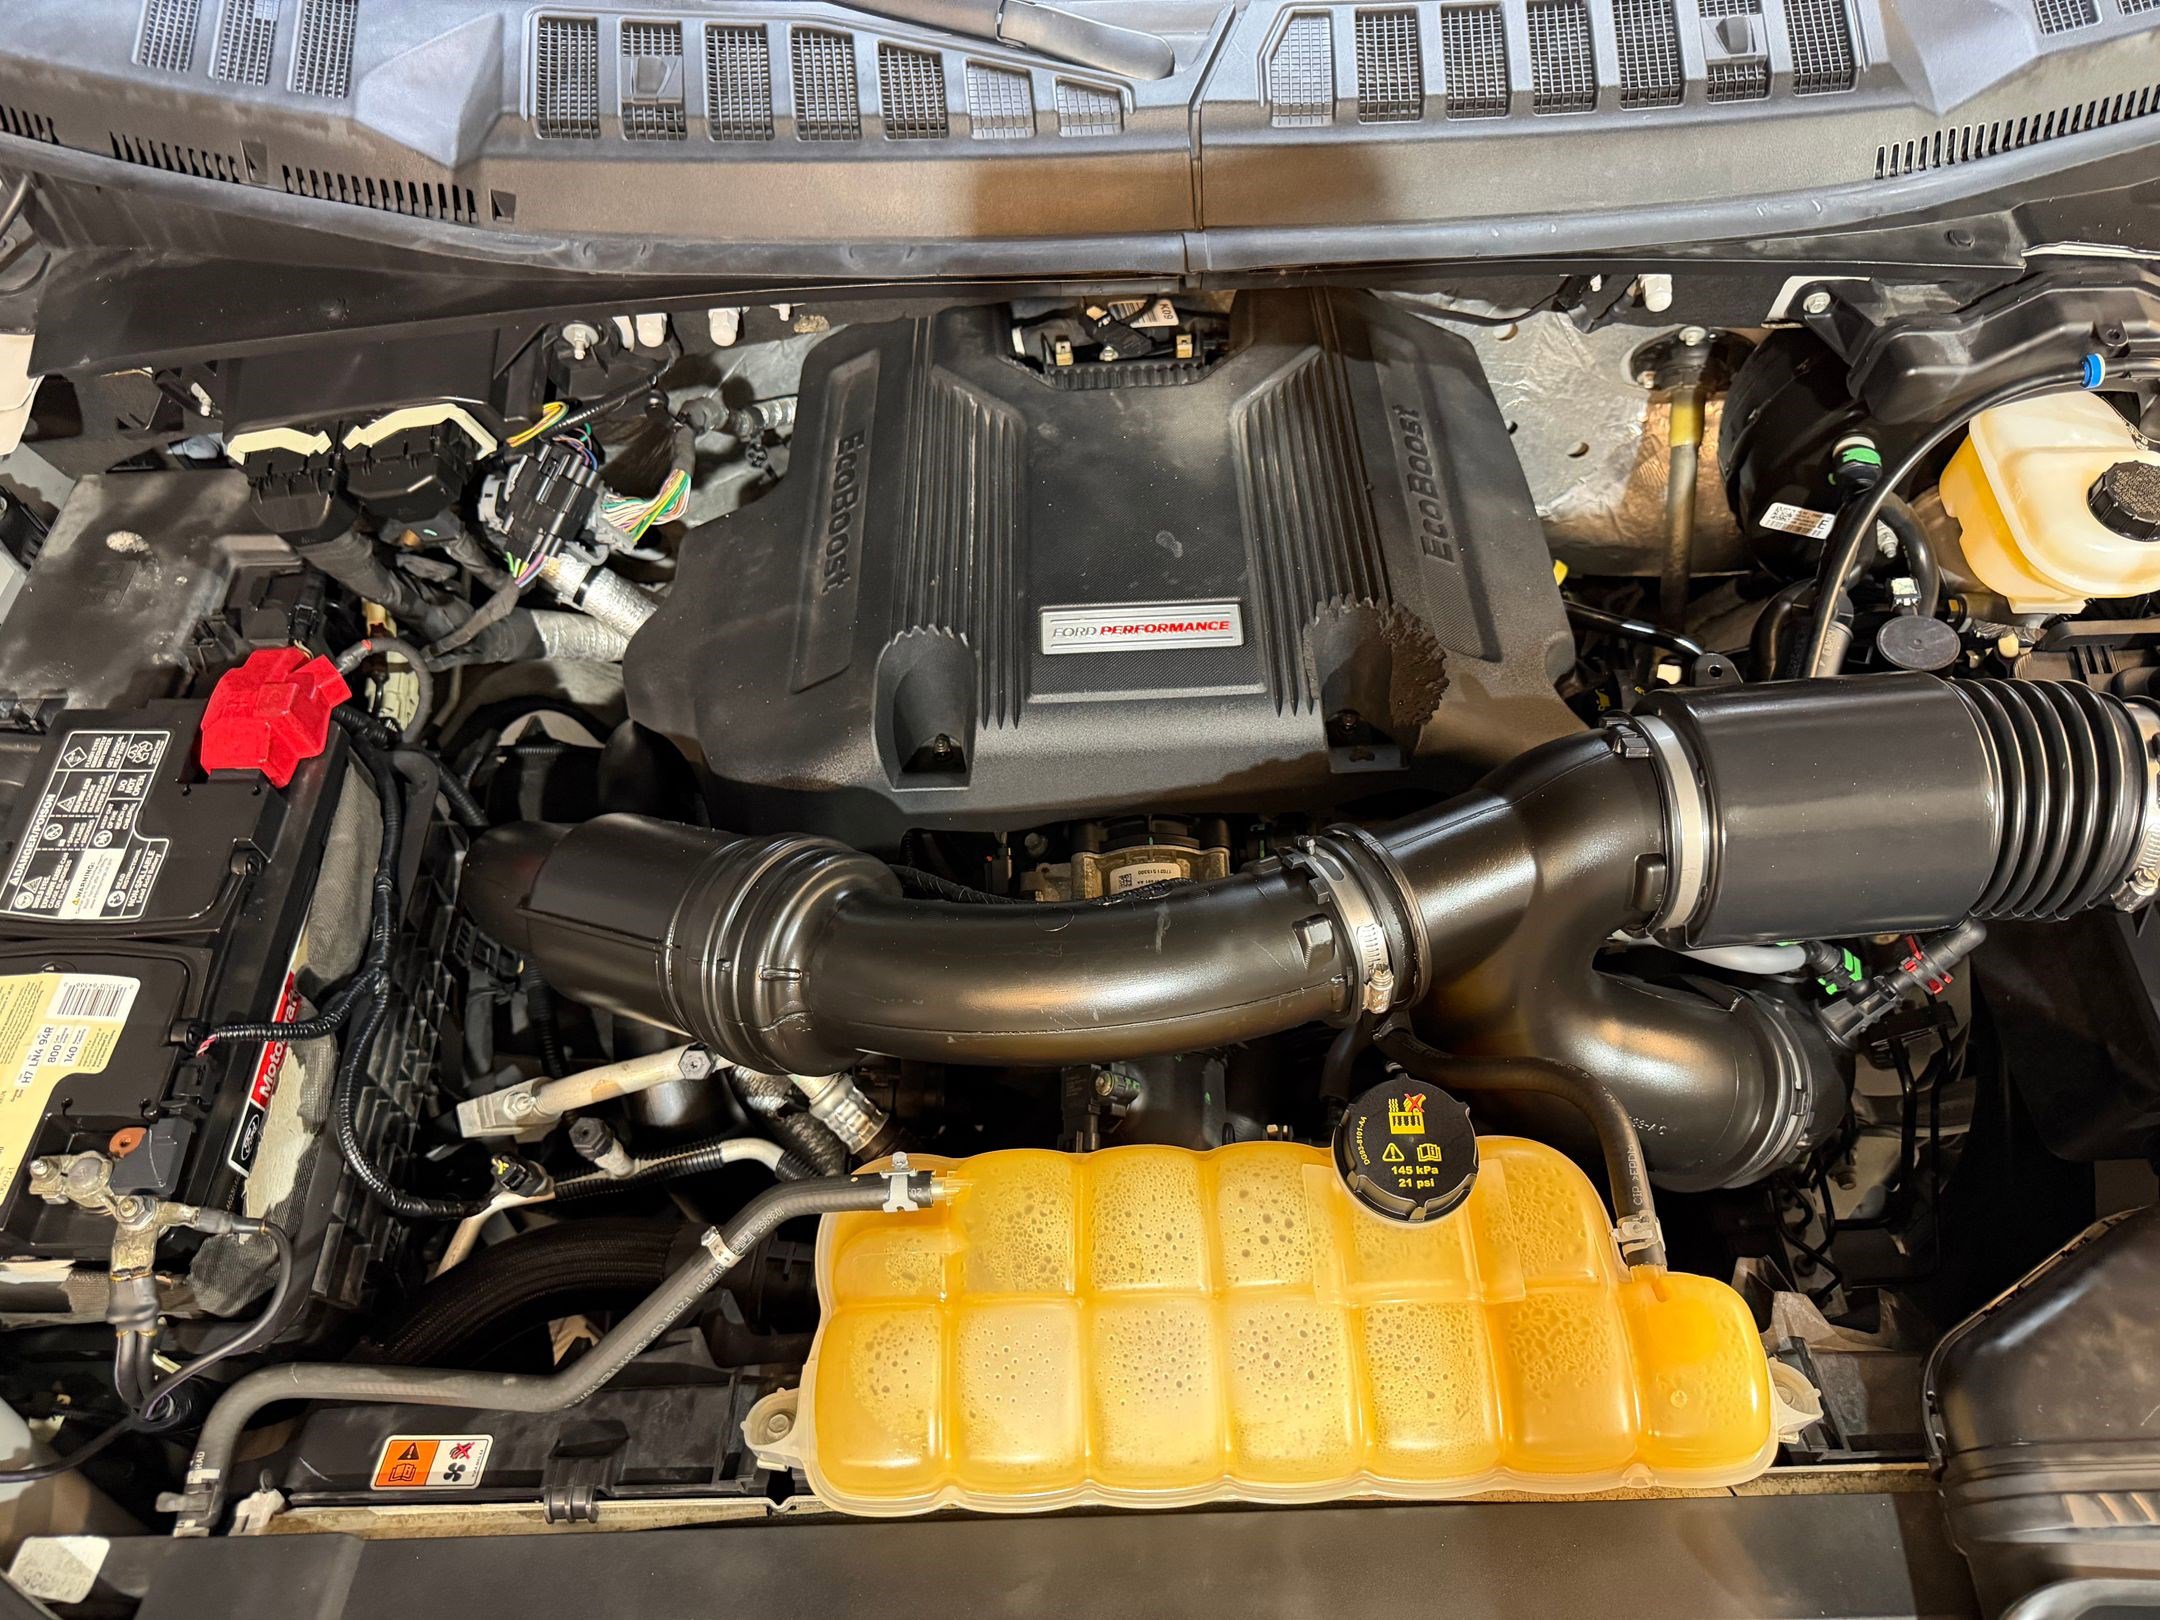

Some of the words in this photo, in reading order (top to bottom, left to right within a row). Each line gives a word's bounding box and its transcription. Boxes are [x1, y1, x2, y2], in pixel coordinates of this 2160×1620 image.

[1392, 404, 1456, 566] EcoBoost
[821, 429, 865, 596] EcoBoost
[1053, 626, 1097, 638] FORD
[1099, 620, 1231, 636] PERFORMANCE
[117, 779, 128, 791] DO
[125, 778, 136, 793] NOT
[13, 794, 56, 877] DANGER/POISON
[127, 849, 155, 907] NON-SPILLABLE
[21, 1071, 33, 1083] H7
[28, 1049, 43, 1067] LN4
[39, 1027, 54, 1045] 94R
[48, 1044, 61, 1063] 800
[64, 1046, 78, 1062] 140
[1356, 1116, 1371, 1166] DG93-8101-AA
[1391, 1166, 1413, 1175] 145
[1416, 1165, 1439, 1175] kPa
[1399, 1178, 1413, 1187] 21
[1417, 1178, 1434, 1189] psi
